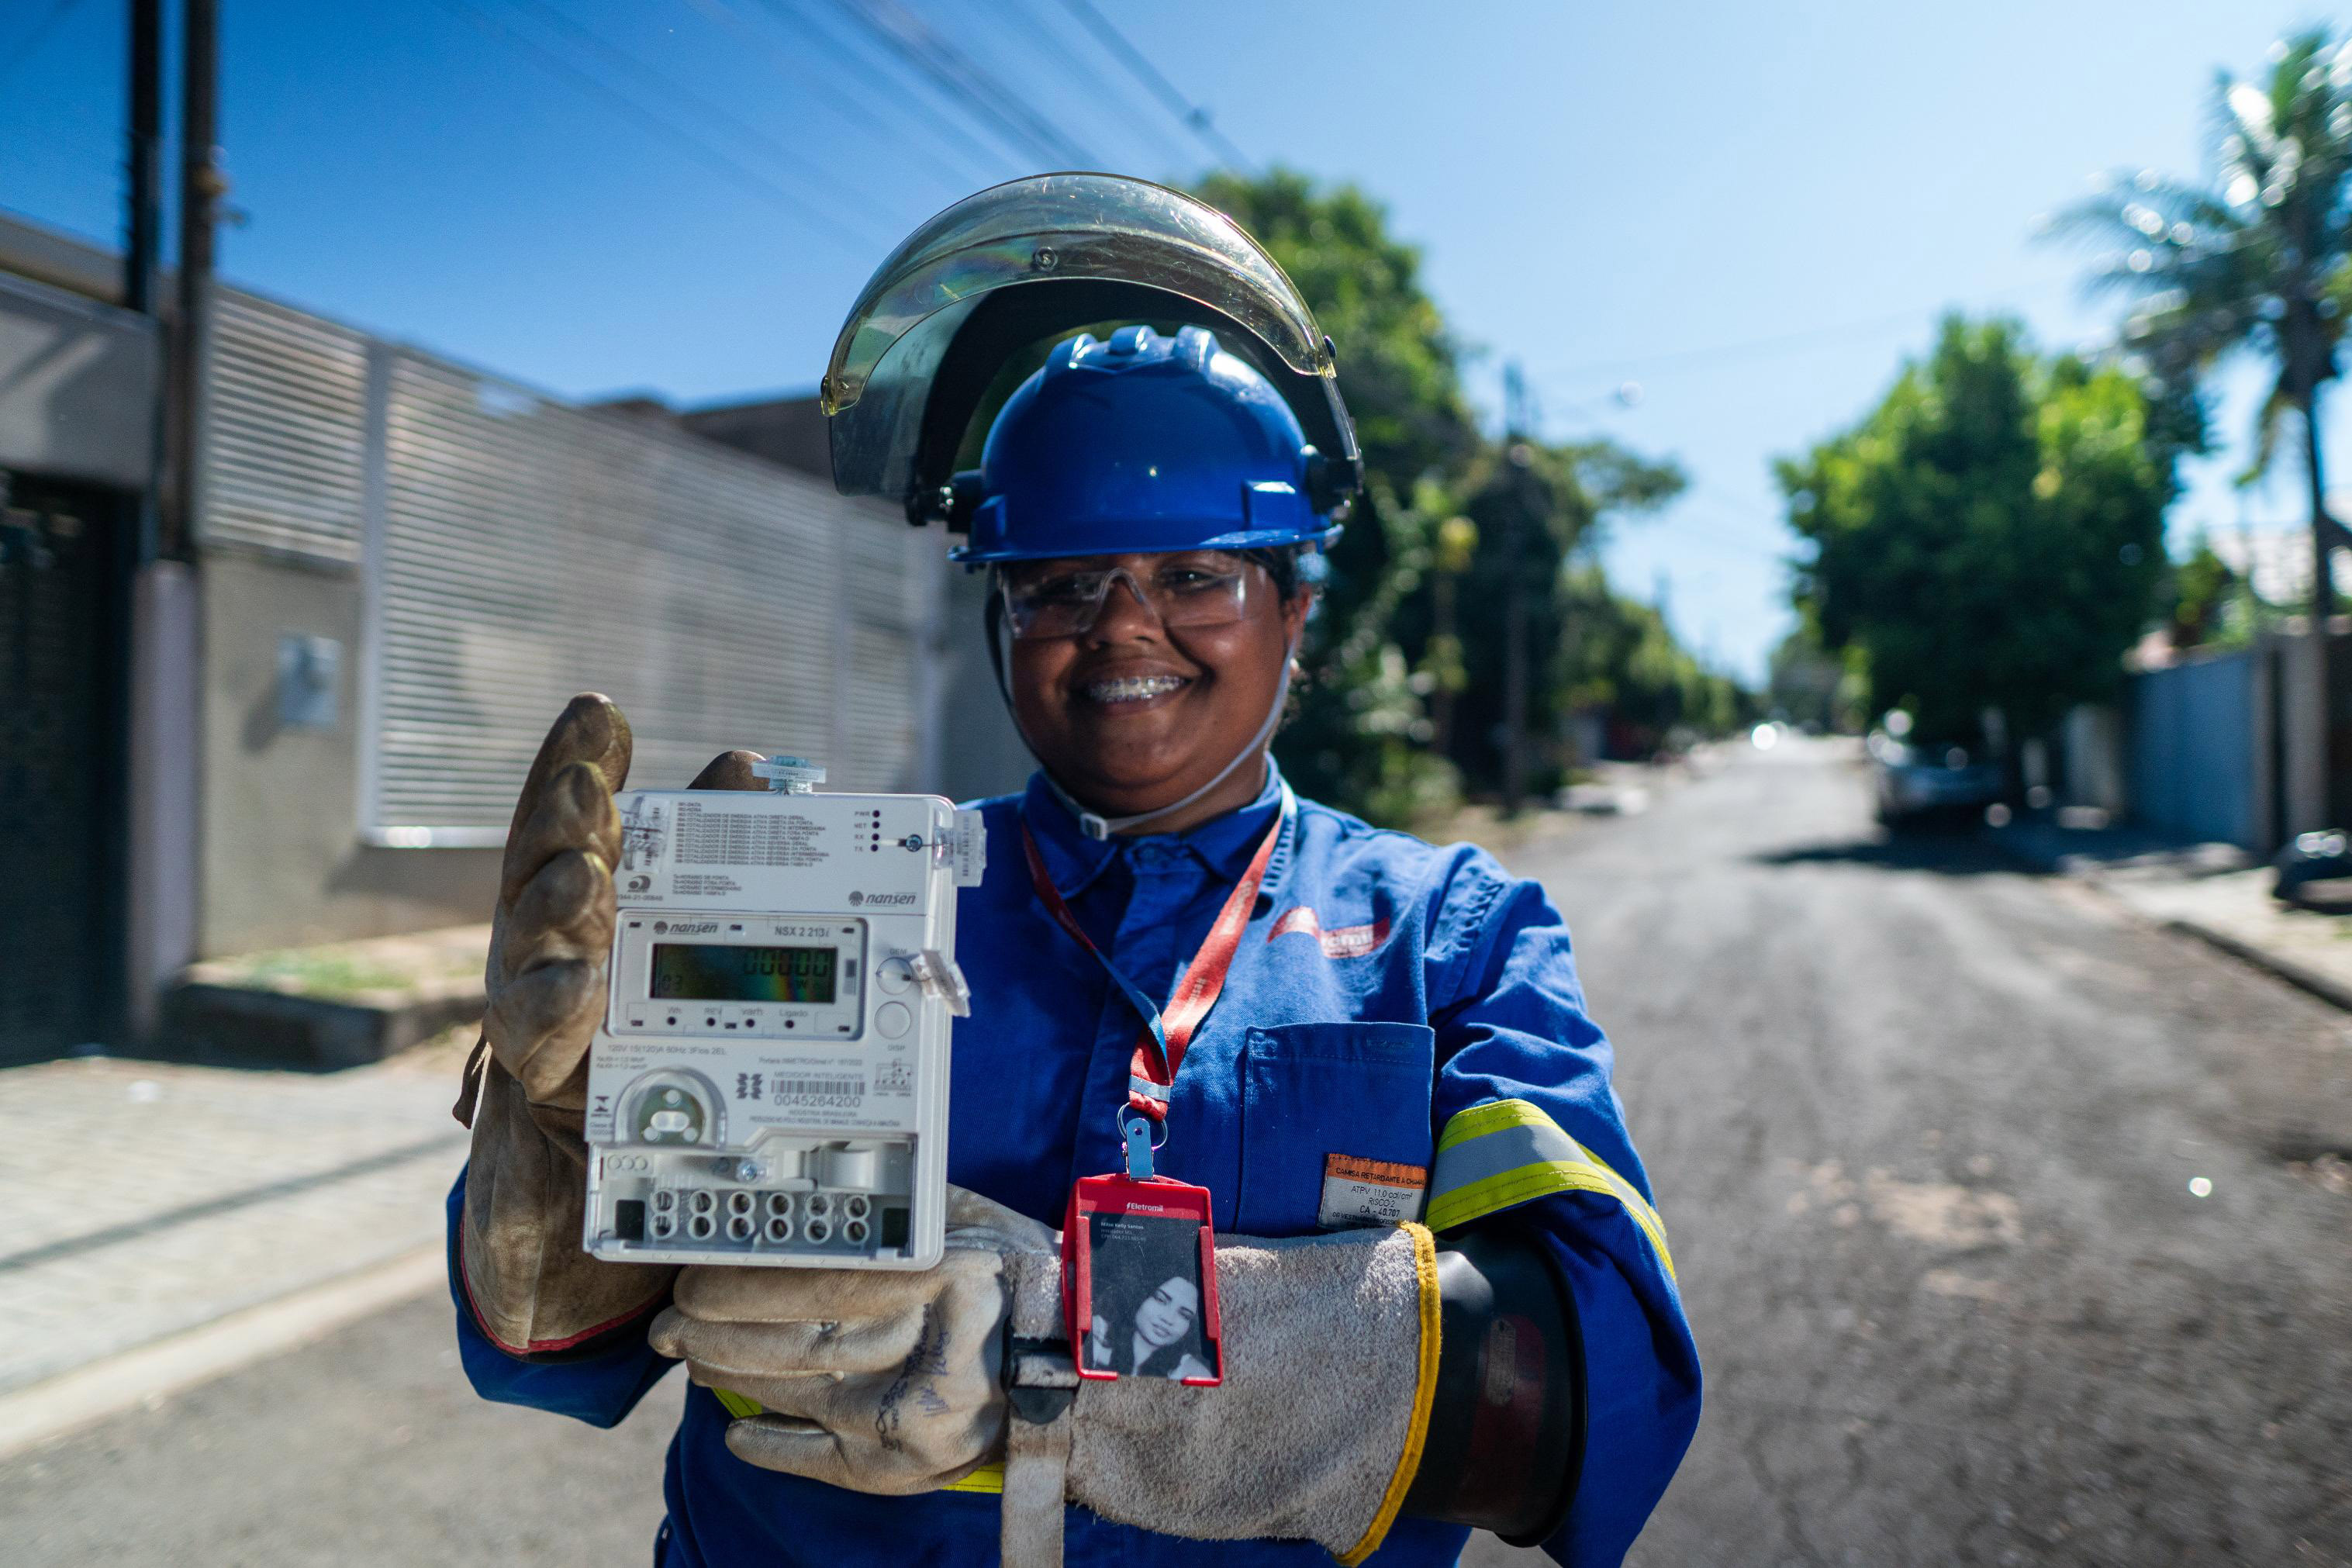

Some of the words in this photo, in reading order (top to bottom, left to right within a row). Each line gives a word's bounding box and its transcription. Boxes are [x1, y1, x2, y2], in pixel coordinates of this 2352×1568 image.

[865, 893, 916, 905] nansen
[670, 923, 718, 933] nansen
[775, 926, 795, 936] NSX
[799, 927, 805, 937] 2
[779, 1010, 808, 1018] Ligado
[1336, 1167, 1359, 1178] CAMISA
[1361, 1172, 1400, 1183] RETARDANTE
[1351, 1186, 1370, 1195] ATPV
[1368, 1197, 1390, 1207] RISCO
[1131, 1203, 1163, 1212] Eletromil
[1360, 1205, 1370, 1214] CA
[1378, 1208, 1400, 1217] 40.707
